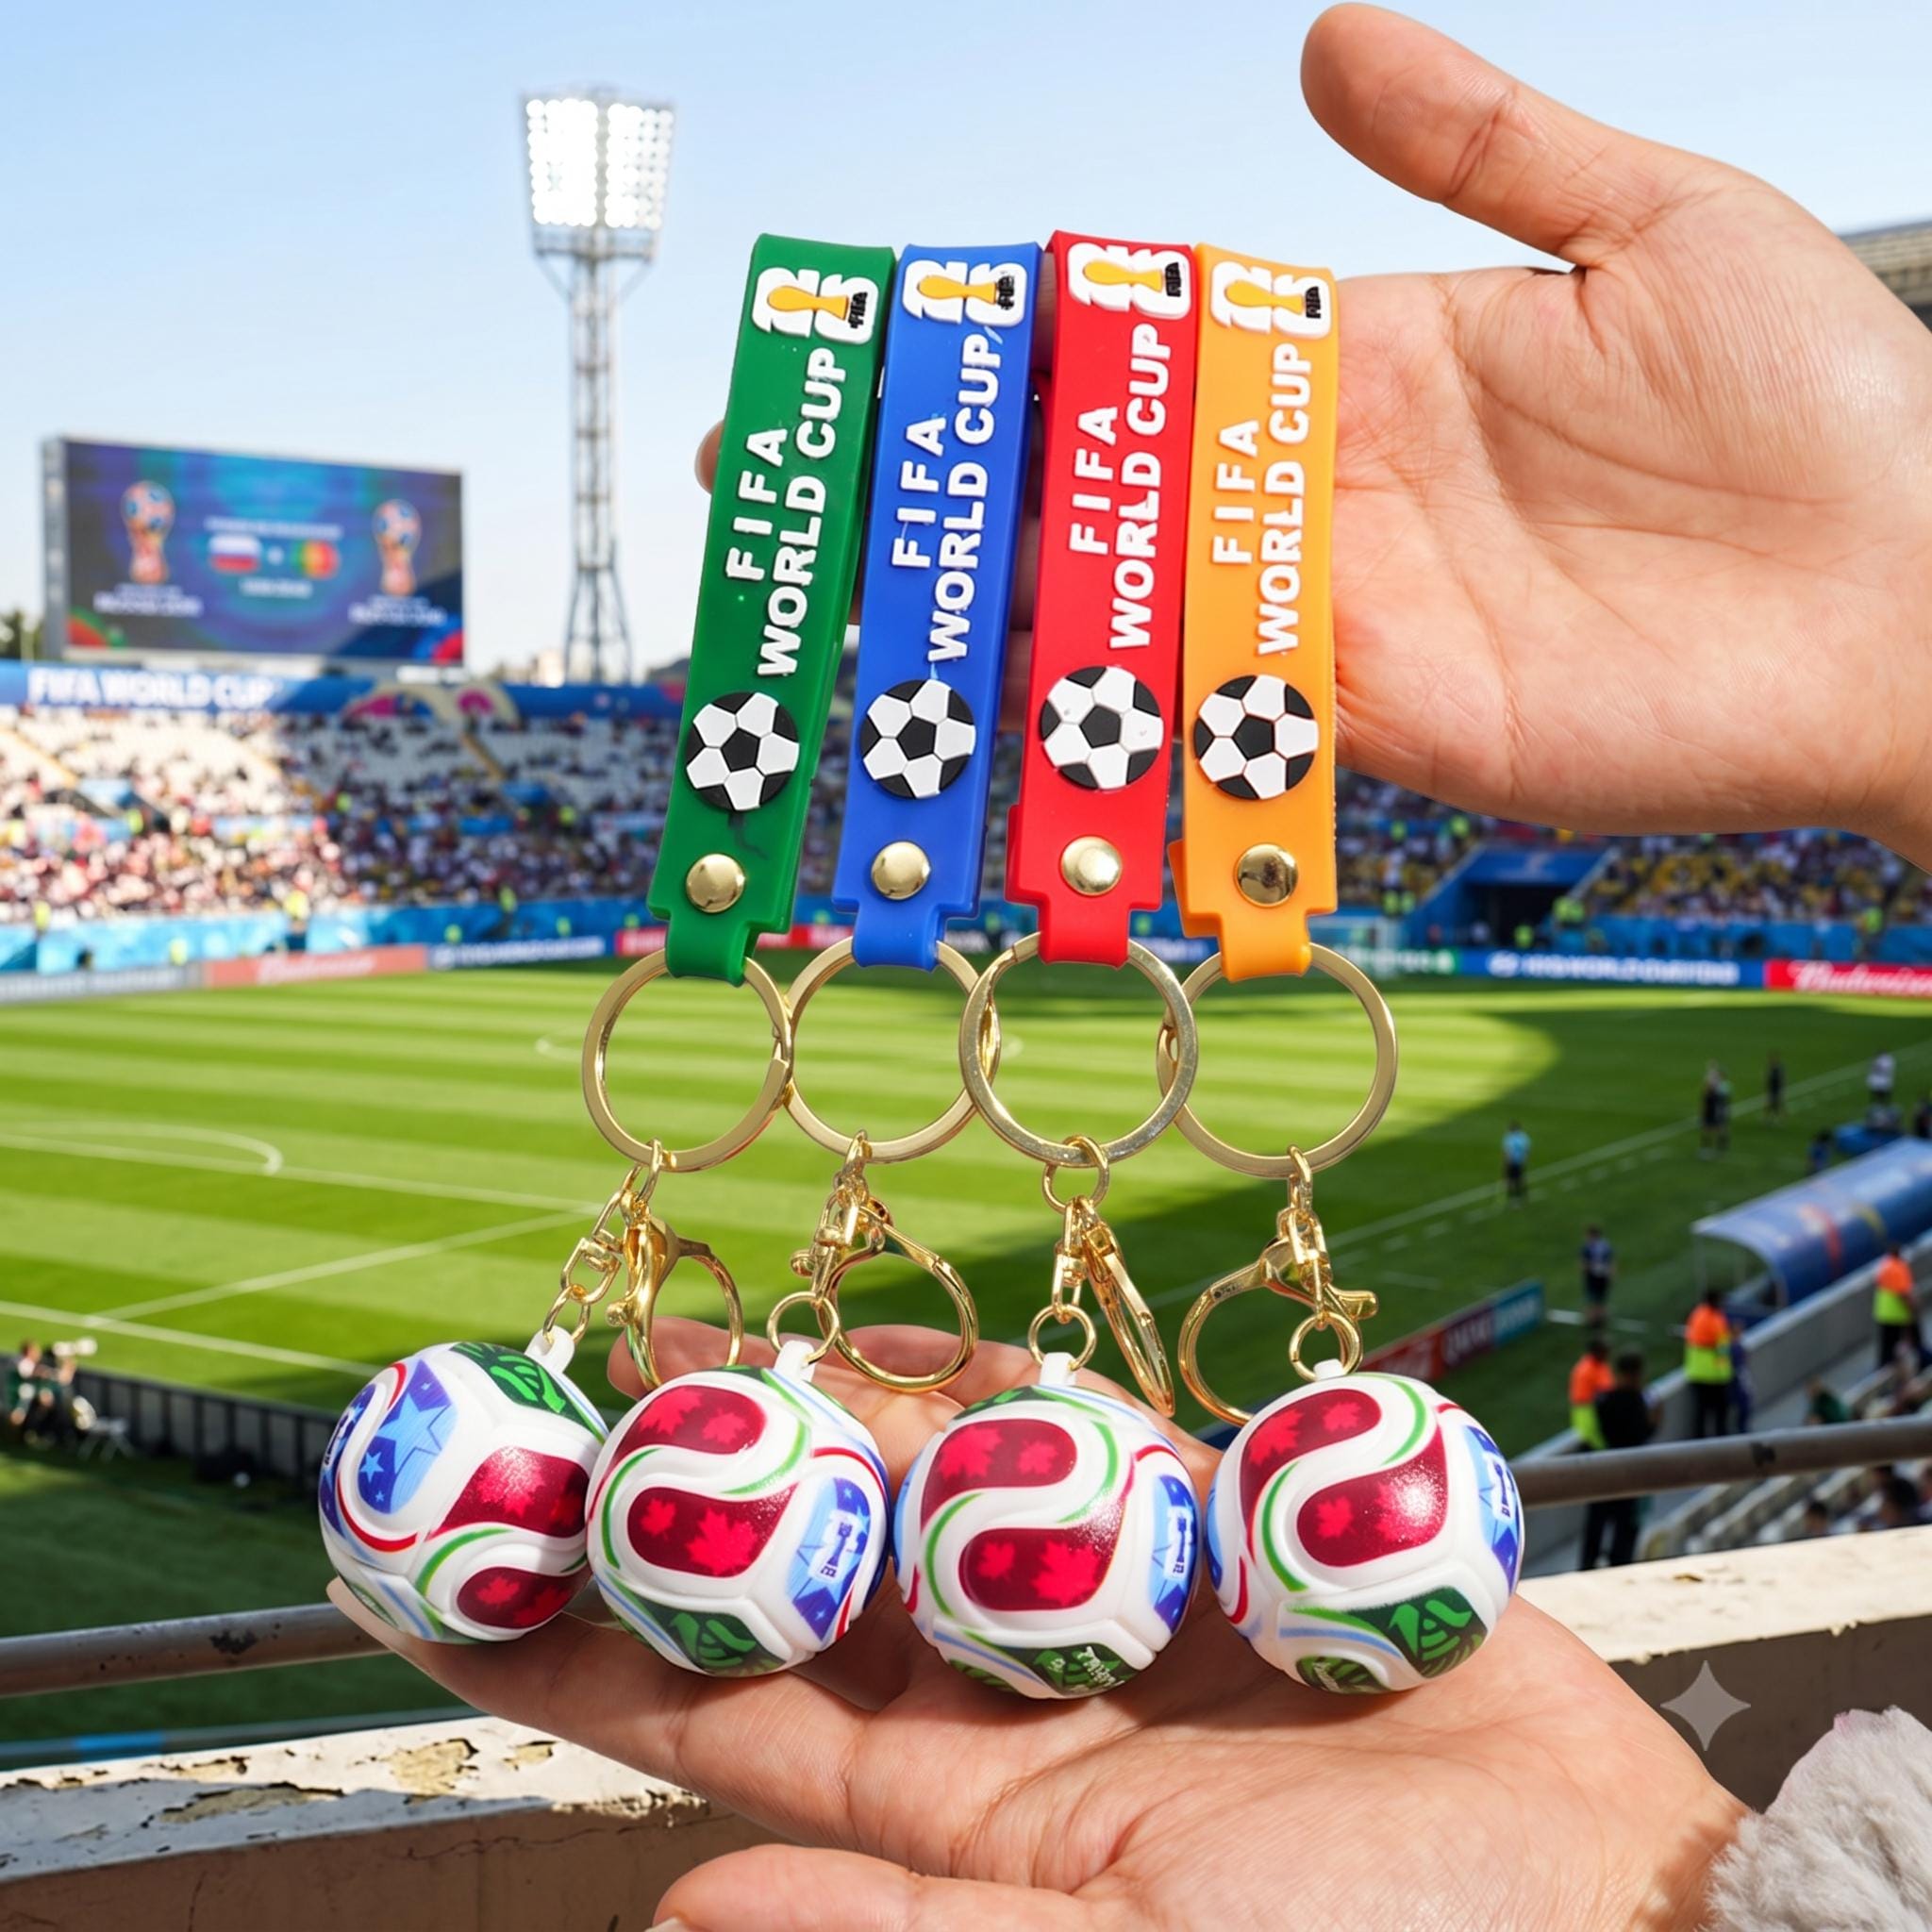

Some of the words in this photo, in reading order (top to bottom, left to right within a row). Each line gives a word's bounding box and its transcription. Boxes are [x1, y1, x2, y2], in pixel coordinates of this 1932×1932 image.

[955, 334, 1001, 444] CUP
[1126, 324, 1171, 435] CUP
[1269, 342, 1312, 443] CUP
[725, 428, 788, 580] FIFA
[758, 475, 826, 675] WORLD
[796, 347, 846, 458] CUP
[891, 417, 946, 568] FIFA
[1070, 407, 1118, 555] FIFA
[1110, 452, 1161, 648] WORLD
[1213, 420, 1259, 563] FIFA
[927, 462, 988, 661] WORLD
[1258, 460, 1306, 655] WORLD
[27, 667, 98, 705] FIFA
[99, 669, 211, 708] WORLD
[212, 674, 275, 710] CUP
